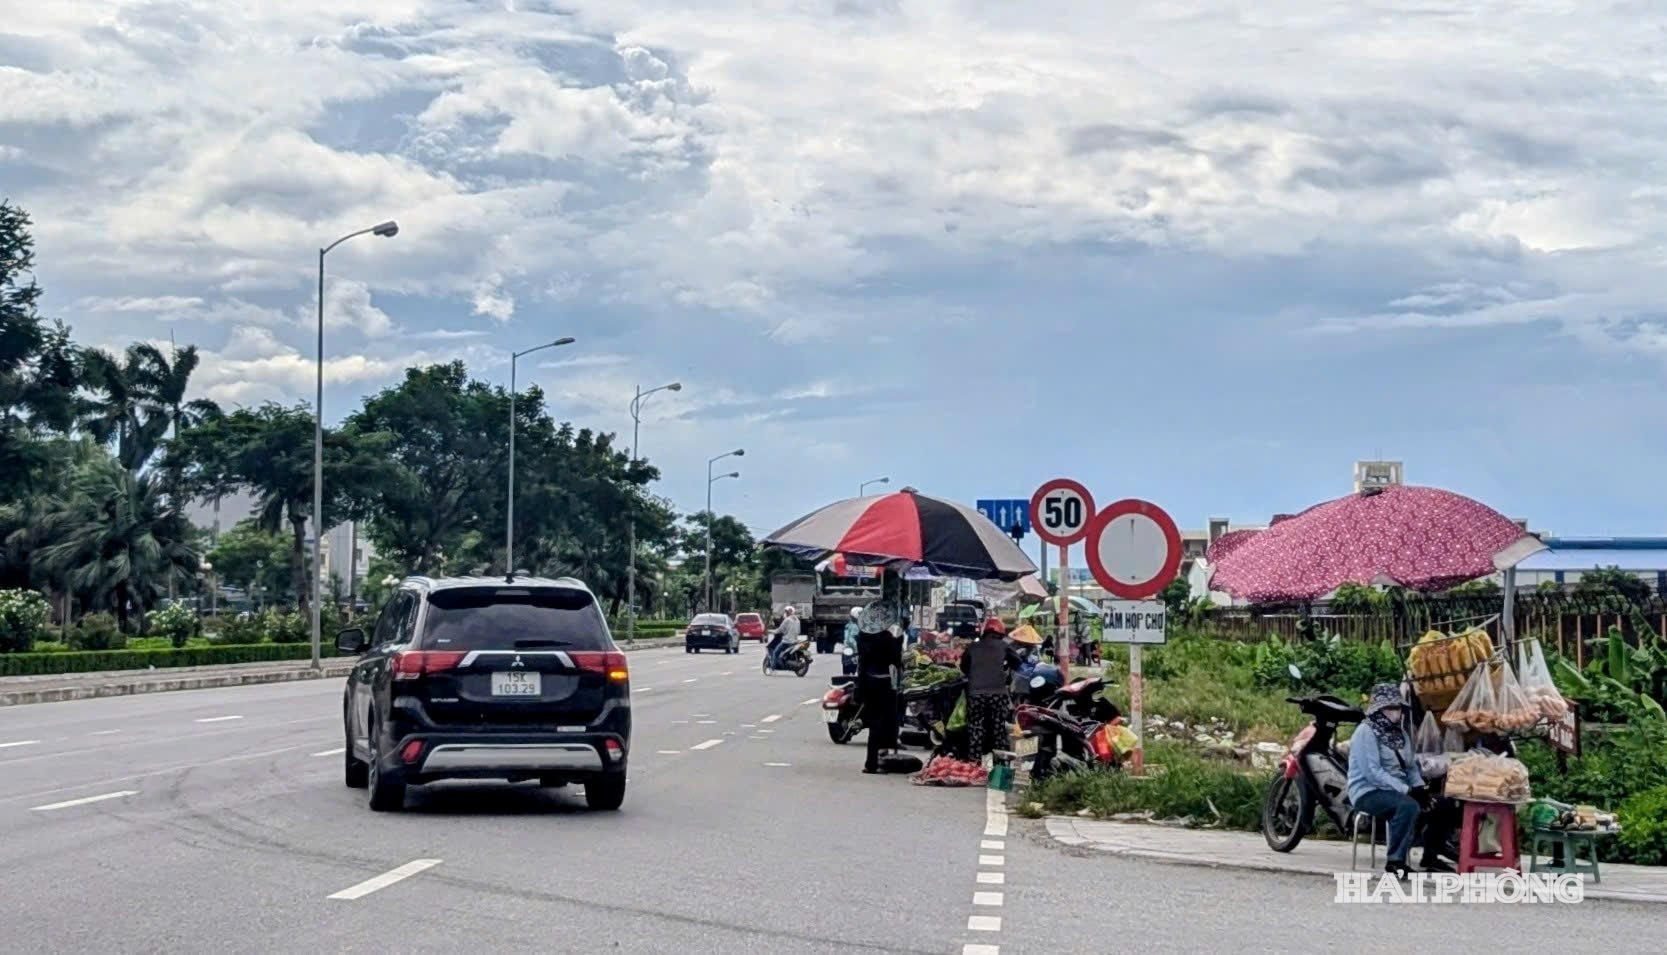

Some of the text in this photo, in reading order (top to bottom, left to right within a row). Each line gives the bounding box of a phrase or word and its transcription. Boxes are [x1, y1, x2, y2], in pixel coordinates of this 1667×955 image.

[1045, 497, 1081, 528] 50
[1145, 611, 1164, 633] CHỢ
[499, 683, 535, 694] 103.29
